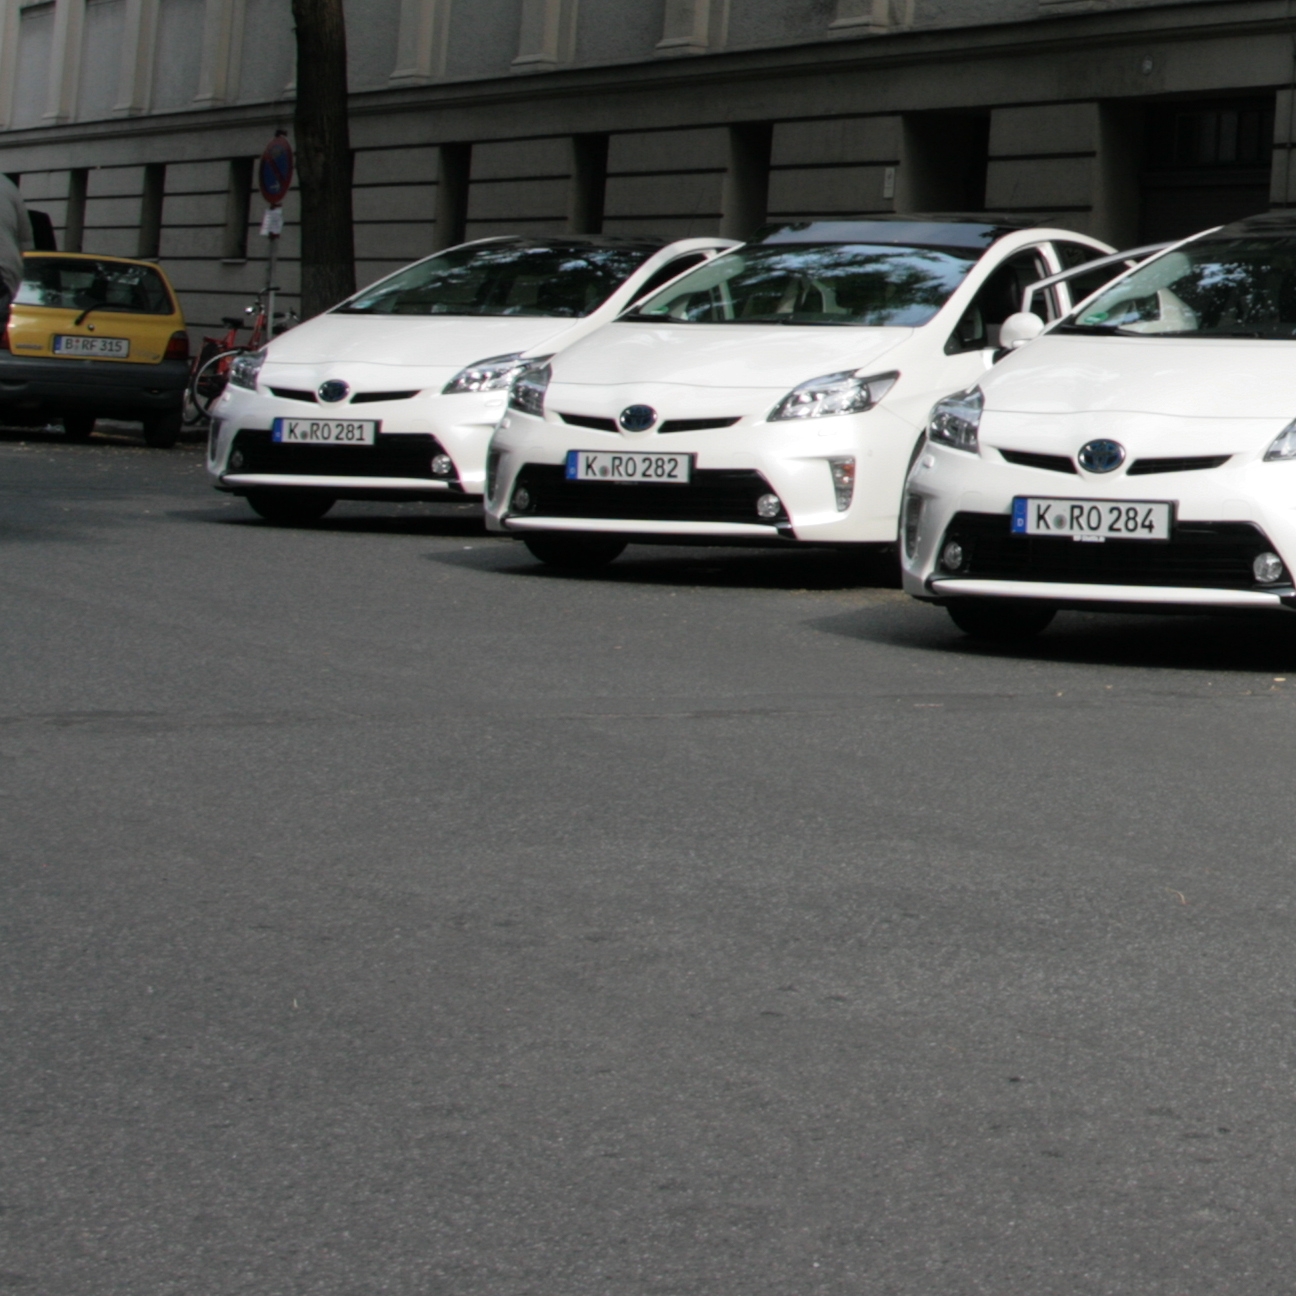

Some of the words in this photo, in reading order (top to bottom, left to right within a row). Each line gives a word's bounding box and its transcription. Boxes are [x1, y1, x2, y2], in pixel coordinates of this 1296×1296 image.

[65, 338, 73, 350] B
[81, 339, 98, 351] RF
[100, 340, 122, 352] 315
[288, 422, 299, 440] K
[334, 423, 366, 442] 281
[585, 455, 598, 477] K
[641, 457, 679, 479] 282
[1036, 504, 1052, 530] K
[1108, 506, 1155, 534] 284
